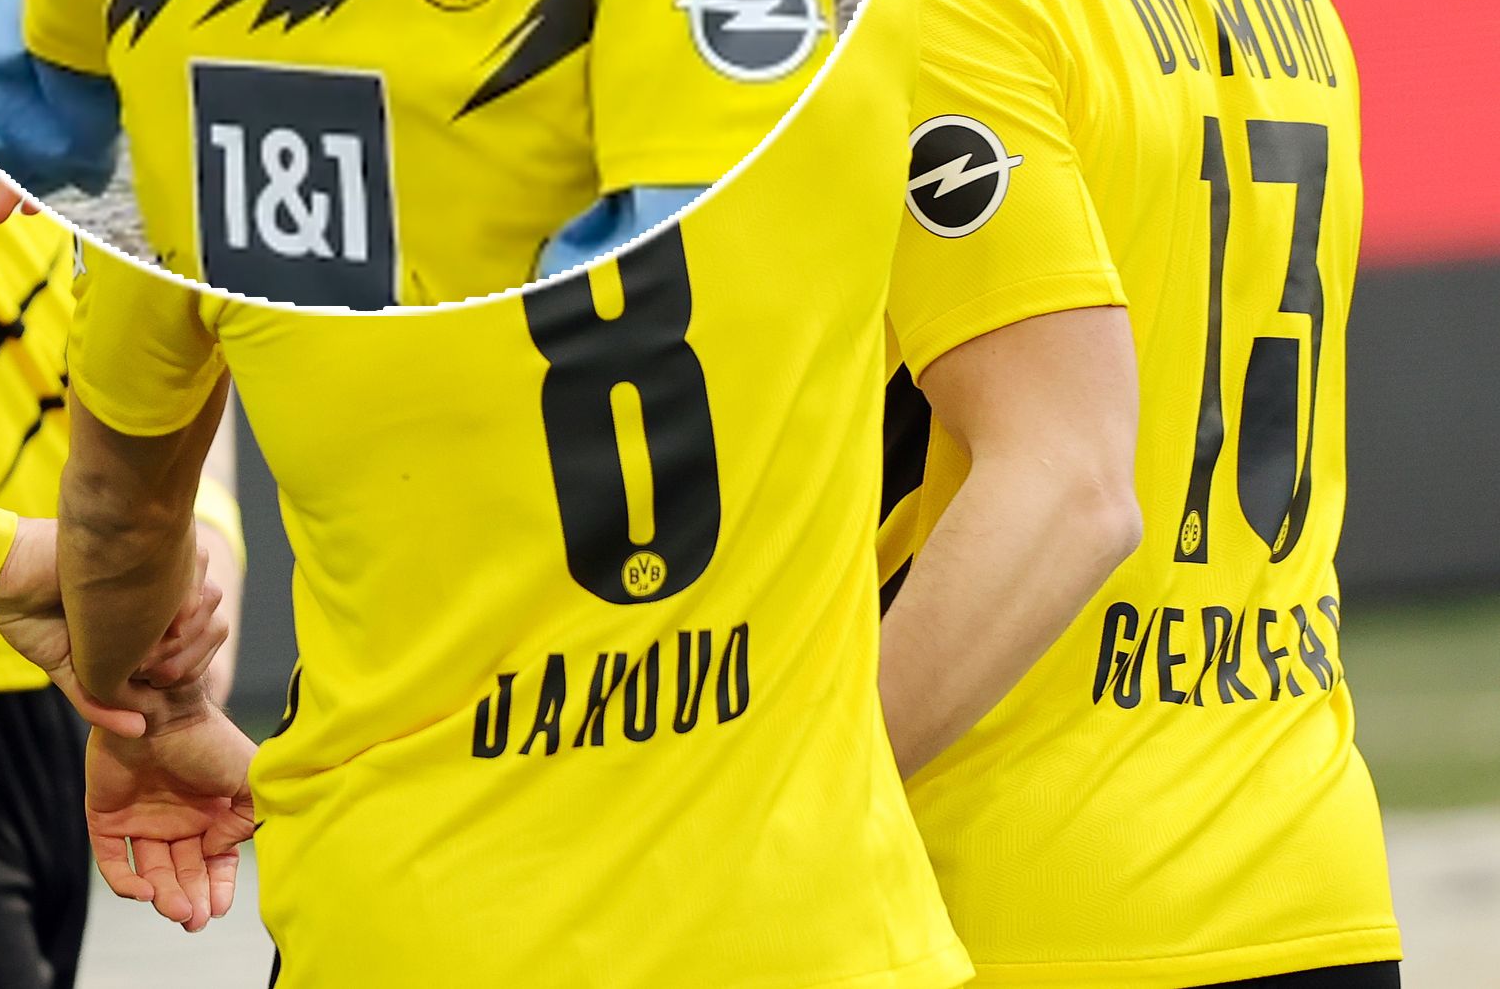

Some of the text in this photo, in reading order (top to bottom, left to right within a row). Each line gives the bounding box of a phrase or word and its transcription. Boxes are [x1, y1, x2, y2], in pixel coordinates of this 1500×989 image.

[210, 124, 368, 262] 1&1
[522, 221, 721, 605] 8
[1173, 115, 1329, 563] 13
[630, 556, 660, 584] BVB
